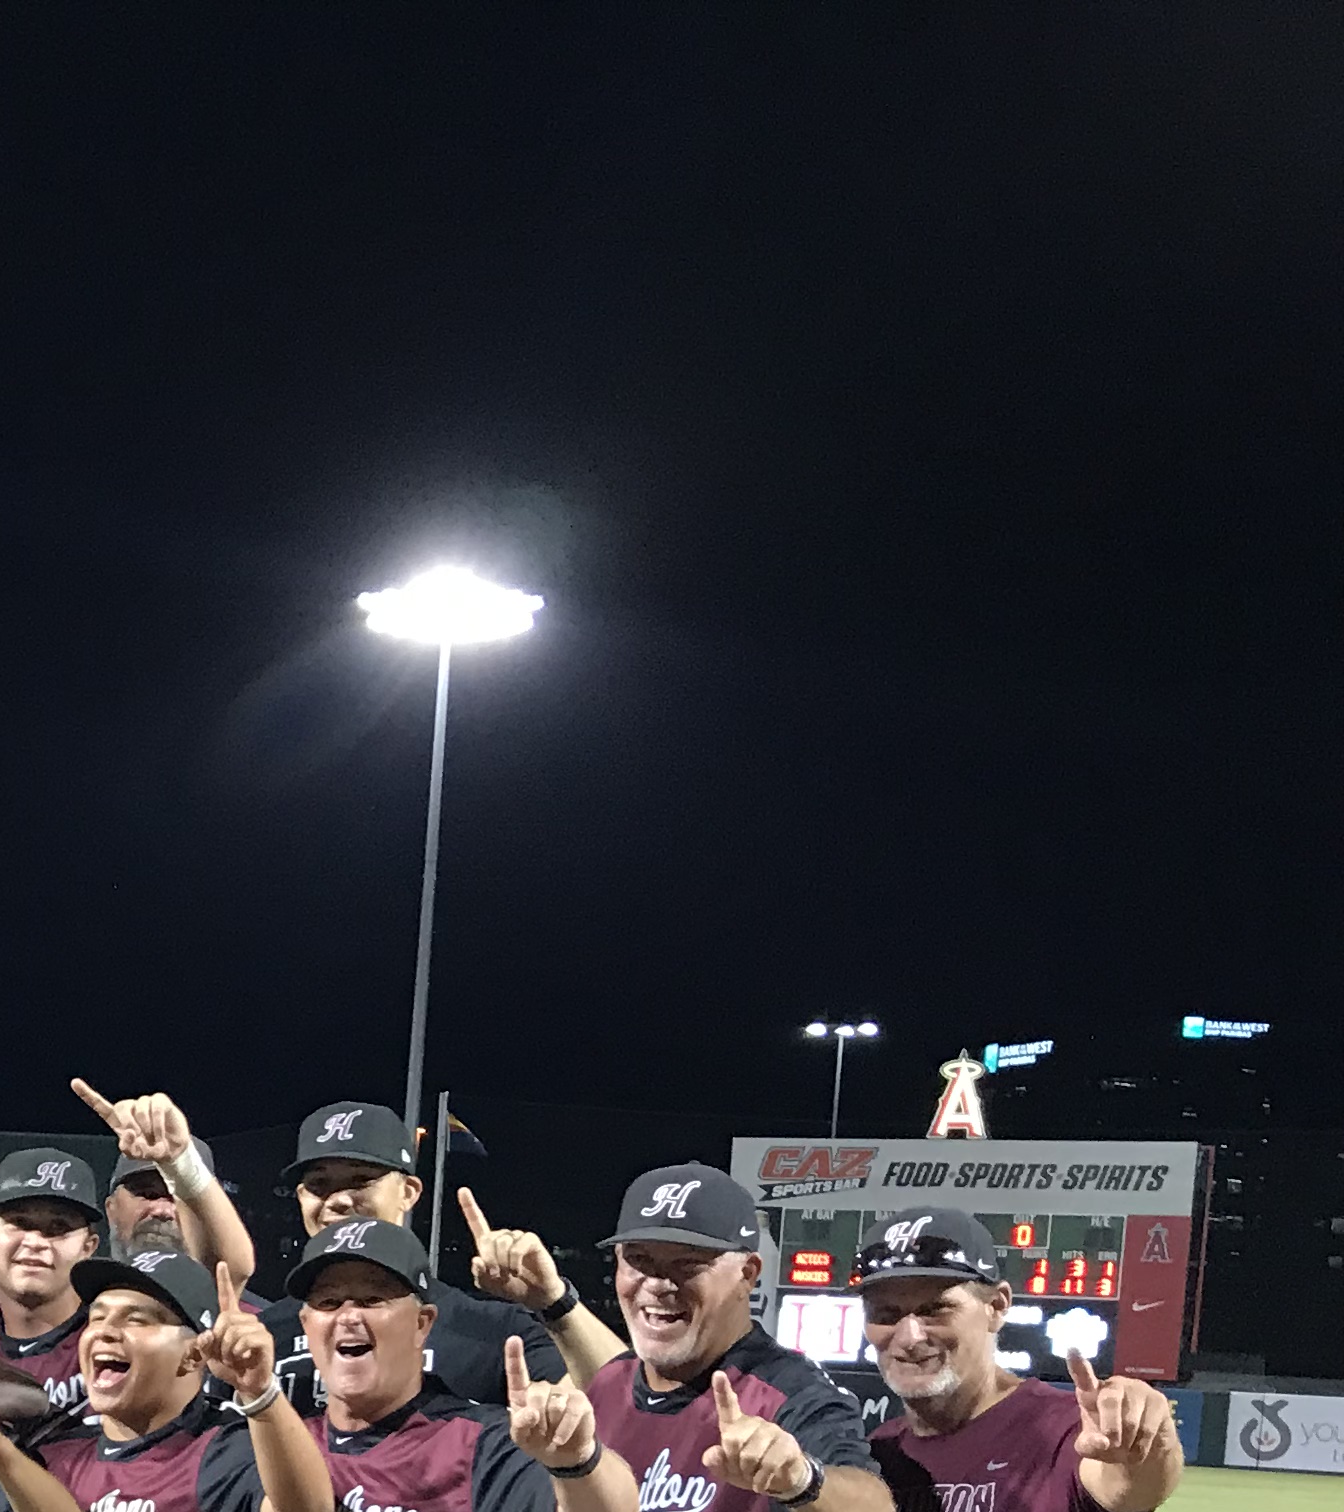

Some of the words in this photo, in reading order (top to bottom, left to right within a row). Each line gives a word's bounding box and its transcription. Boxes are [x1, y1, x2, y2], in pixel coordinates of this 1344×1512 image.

[758, 1146, 879, 1181] CAZ
[771, 1179, 833, 1198] SPORTS
[835, 1178, 861, 1190] BAR
